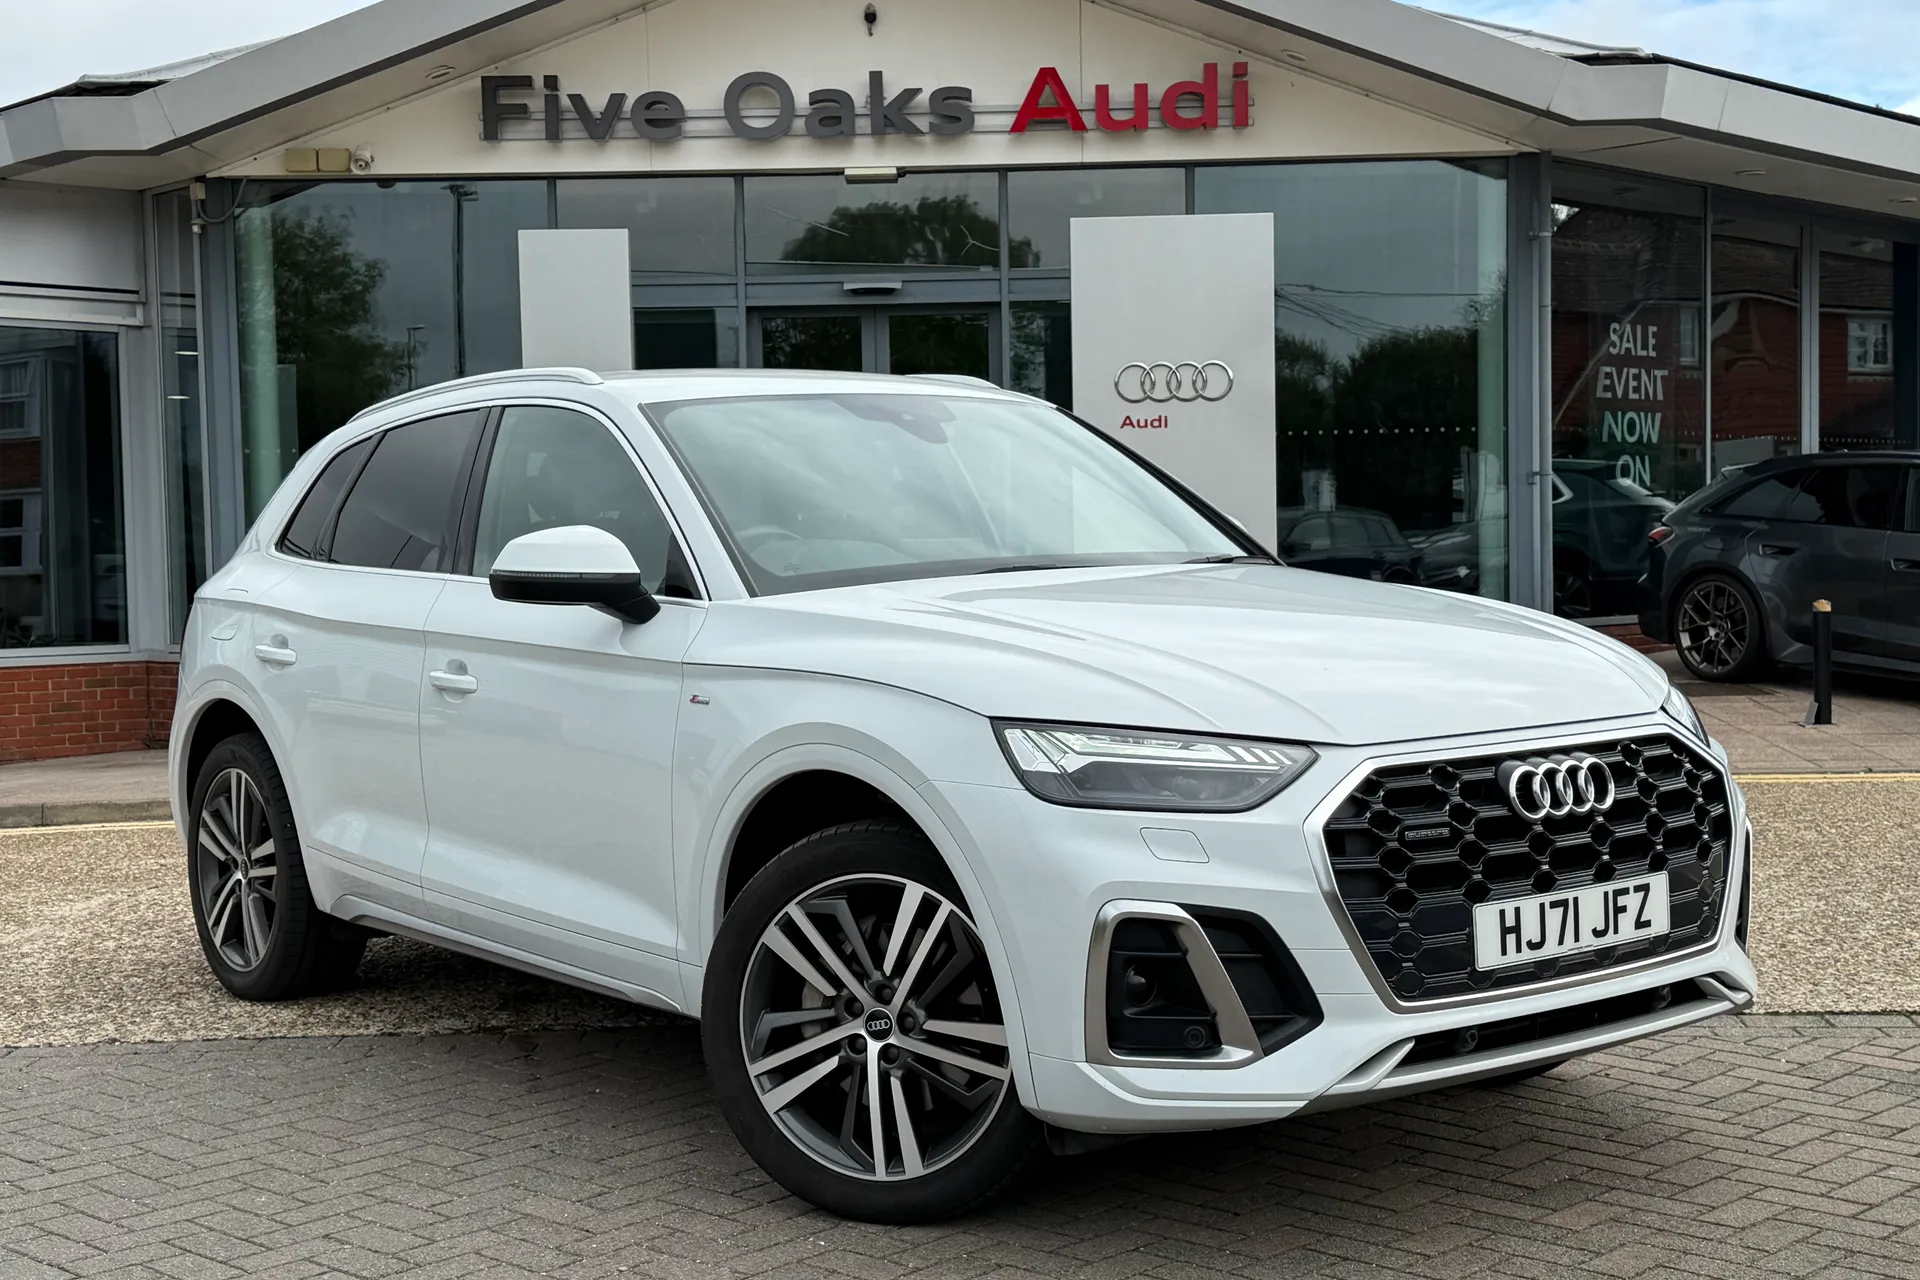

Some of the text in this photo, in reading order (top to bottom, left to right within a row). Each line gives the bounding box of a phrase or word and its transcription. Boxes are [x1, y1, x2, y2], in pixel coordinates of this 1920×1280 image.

[480, 62, 1250, 141] Five Oaks Audi
[1608, 322, 1658, 357] SALE
[1596, 365, 1669, 401] EVENT
[1119, 415, 1168, 429] Audi
[1602, 410, 1662, 443] NOW
[1615, 454, 1651, 487] ON
[1499, 882, 1653, 956] HJ71 JFZ
